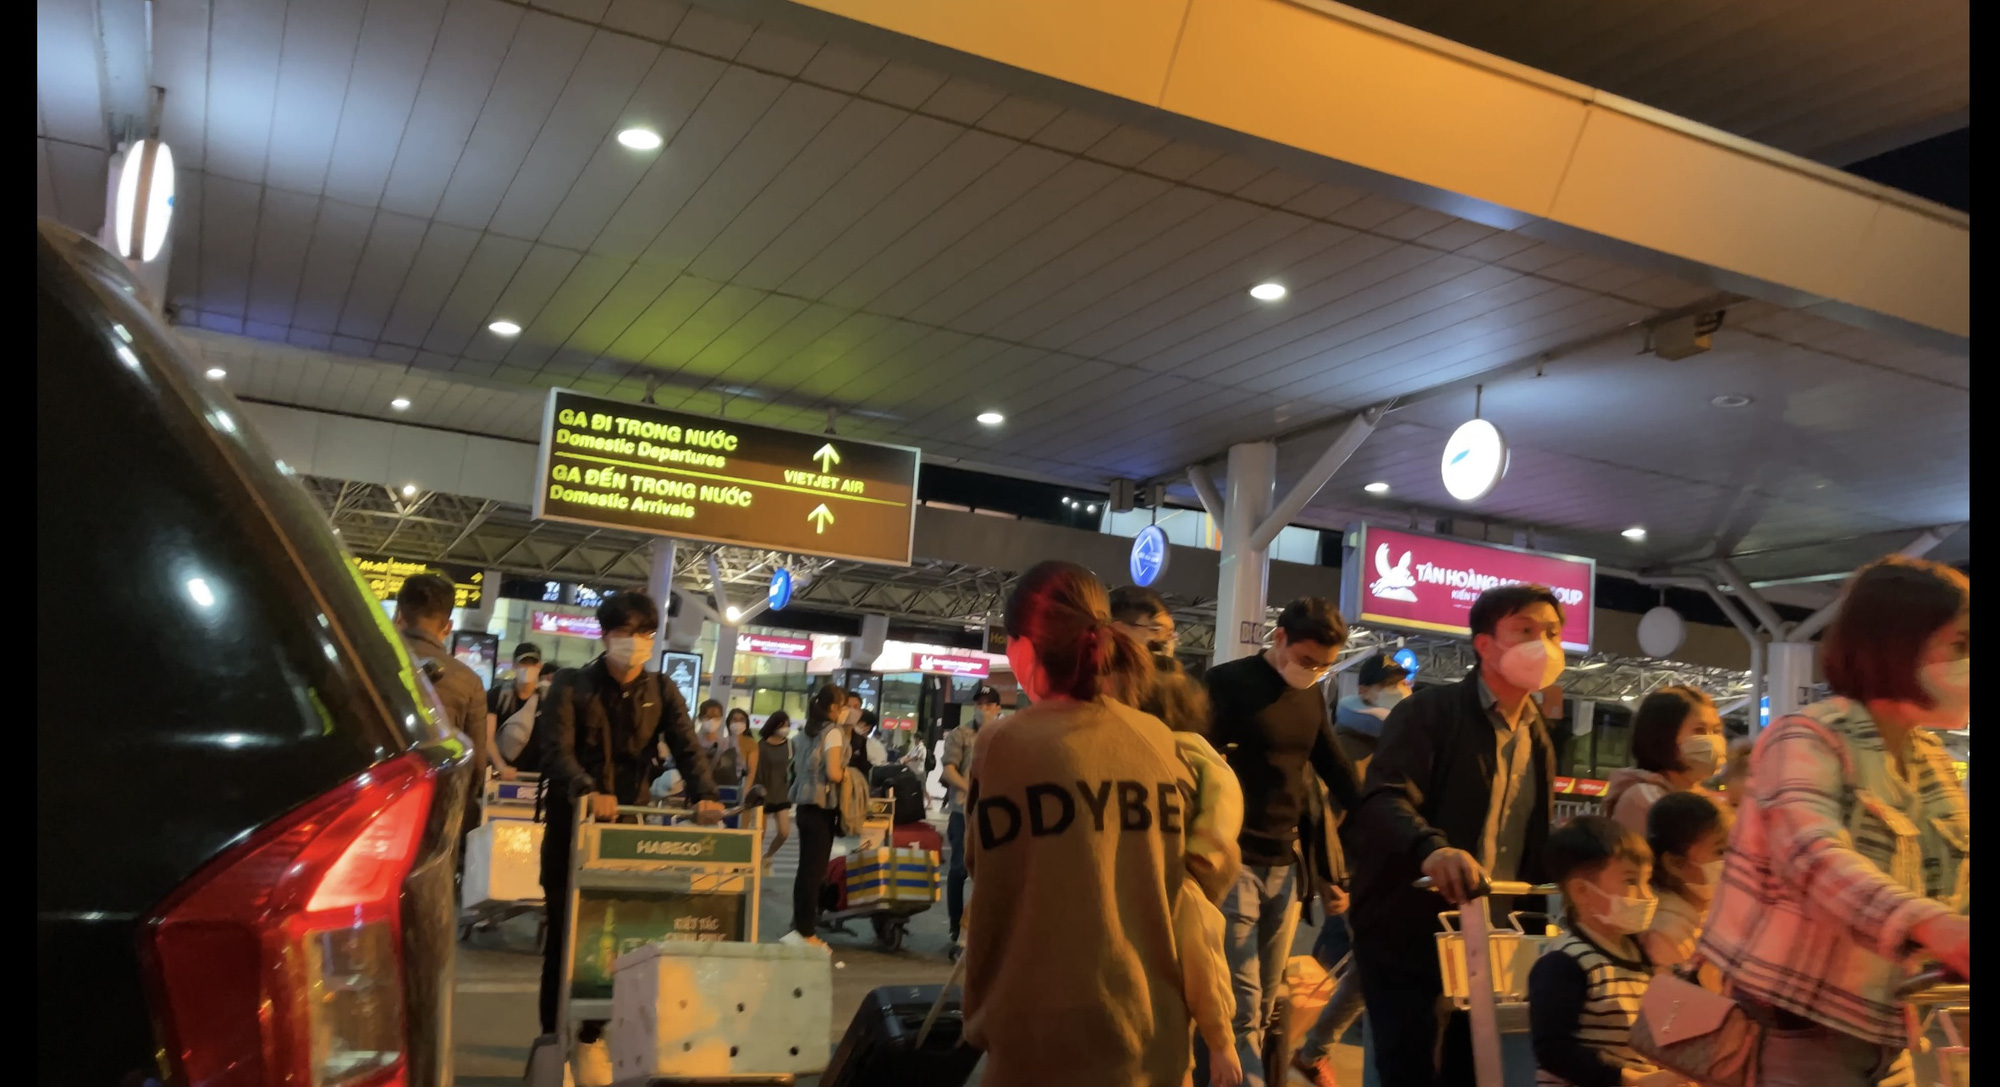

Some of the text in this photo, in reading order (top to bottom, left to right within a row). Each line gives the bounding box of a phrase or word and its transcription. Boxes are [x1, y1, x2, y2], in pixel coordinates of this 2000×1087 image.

[559, 408, 738, 451] GA ĐI TRONG NƯỚC
[556, 428, 726, 468] Domestic Departures
[552, 463, 752, 507] GA ĐẾN TRONG NƯỚC
[784, 469, 864, 494] VIETJET AIR
[550, 484, 695, 519] Domestic Arrivals
[1415, 562, 1446, 584] TÂN
[1445, 568, 1499, 590] HOÀNG
[637, 840, 700, 857] HABECO
